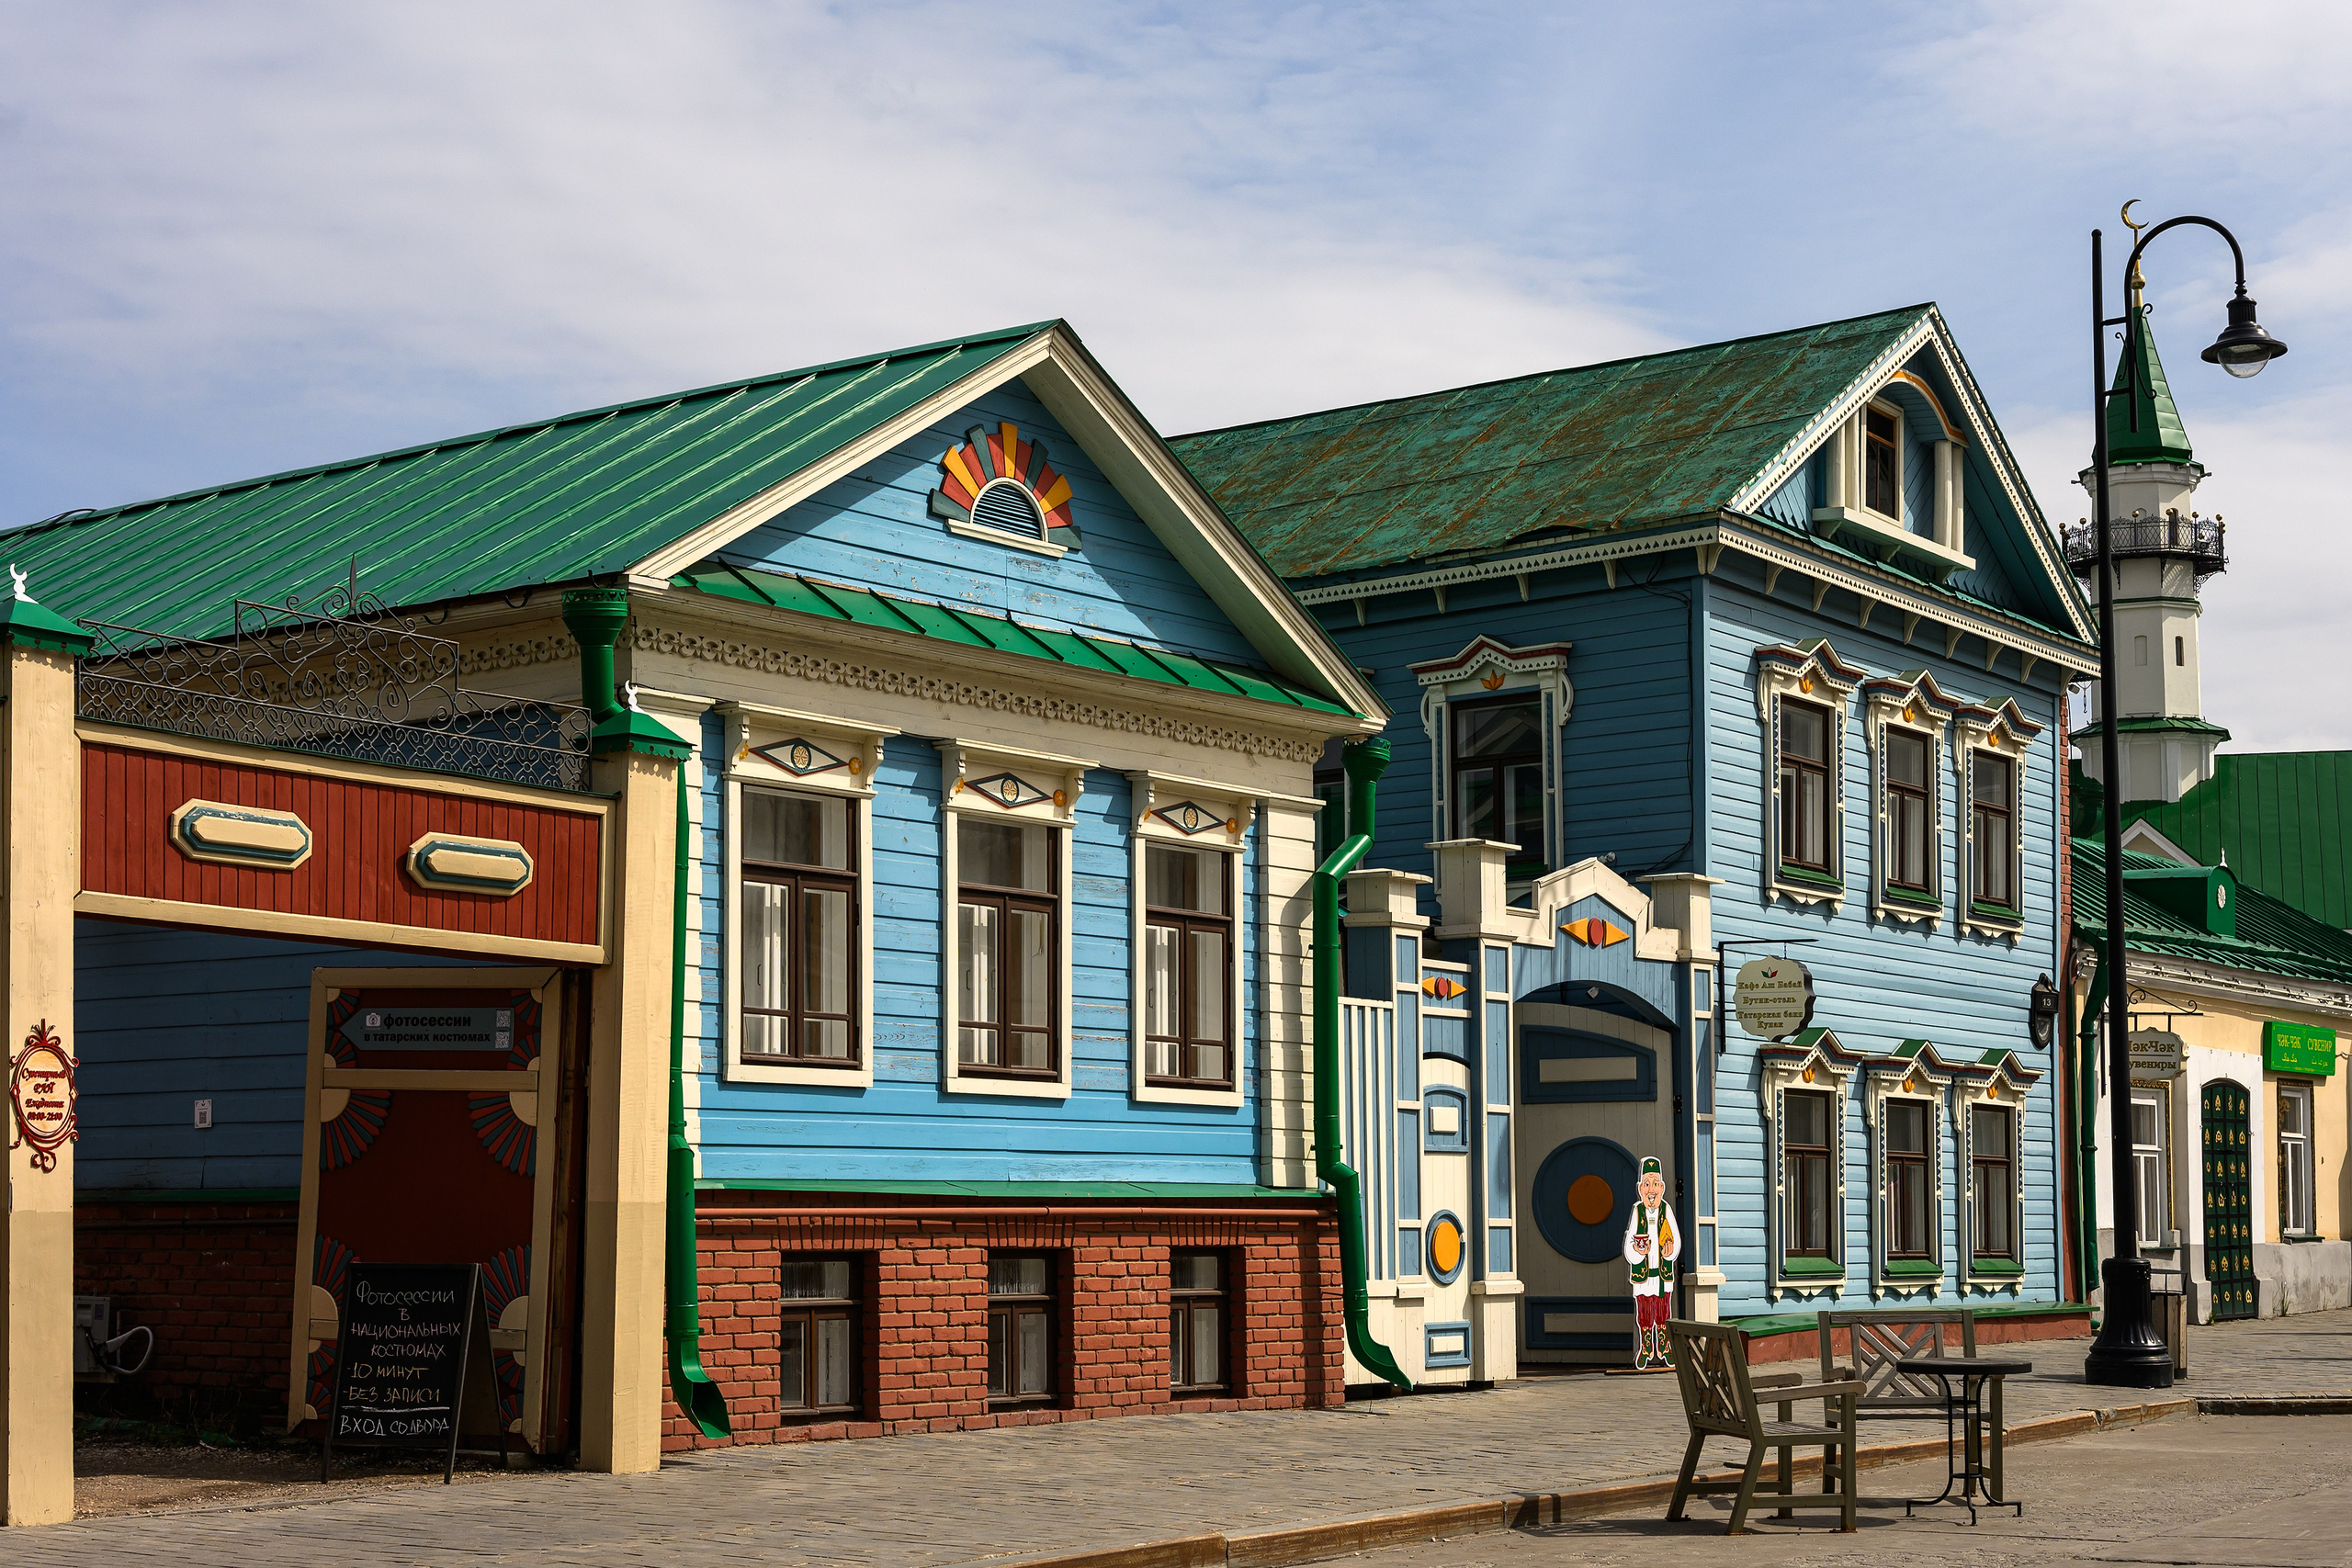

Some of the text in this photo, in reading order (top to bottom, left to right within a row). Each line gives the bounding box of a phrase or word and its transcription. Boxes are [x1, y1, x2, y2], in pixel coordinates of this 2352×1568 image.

[1742, 996, 1796, 1005] Бутик-отель
[2042, 998, 2052, 1007] 13
[383, 1013, 471, 1030] фотосессии
[364, 1032, 491, 1043] в татарских костюмах
[2307, 1037, 2333, 1053] СУВЕНИР
[2129, 1060, 2177, 1071] увениры
[340, 1415, 387, 1436] ВХОД
